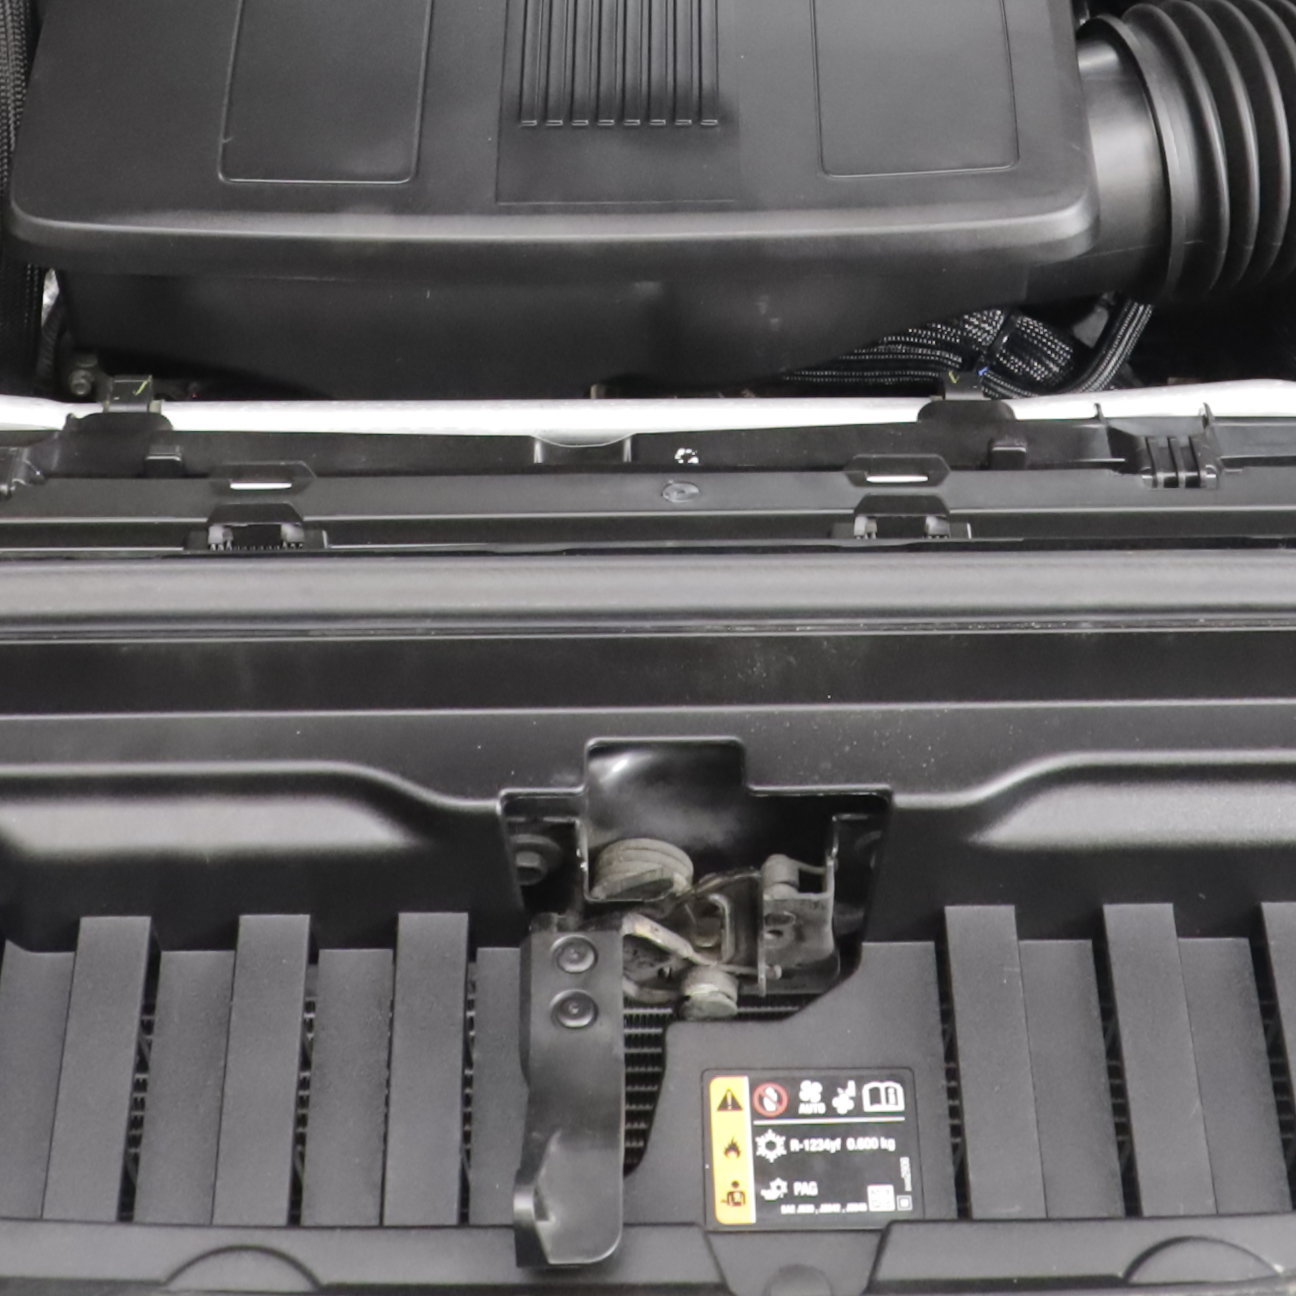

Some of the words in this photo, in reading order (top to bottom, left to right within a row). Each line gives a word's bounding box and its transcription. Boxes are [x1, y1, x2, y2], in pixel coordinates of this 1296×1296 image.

[797, 1102, 826, 1115] AUTO
[789, 1137, 842, 1154] R-1234yf
[880, 1136, 896, 1153] kg
[792, 1180, 819, 1197] PAG
